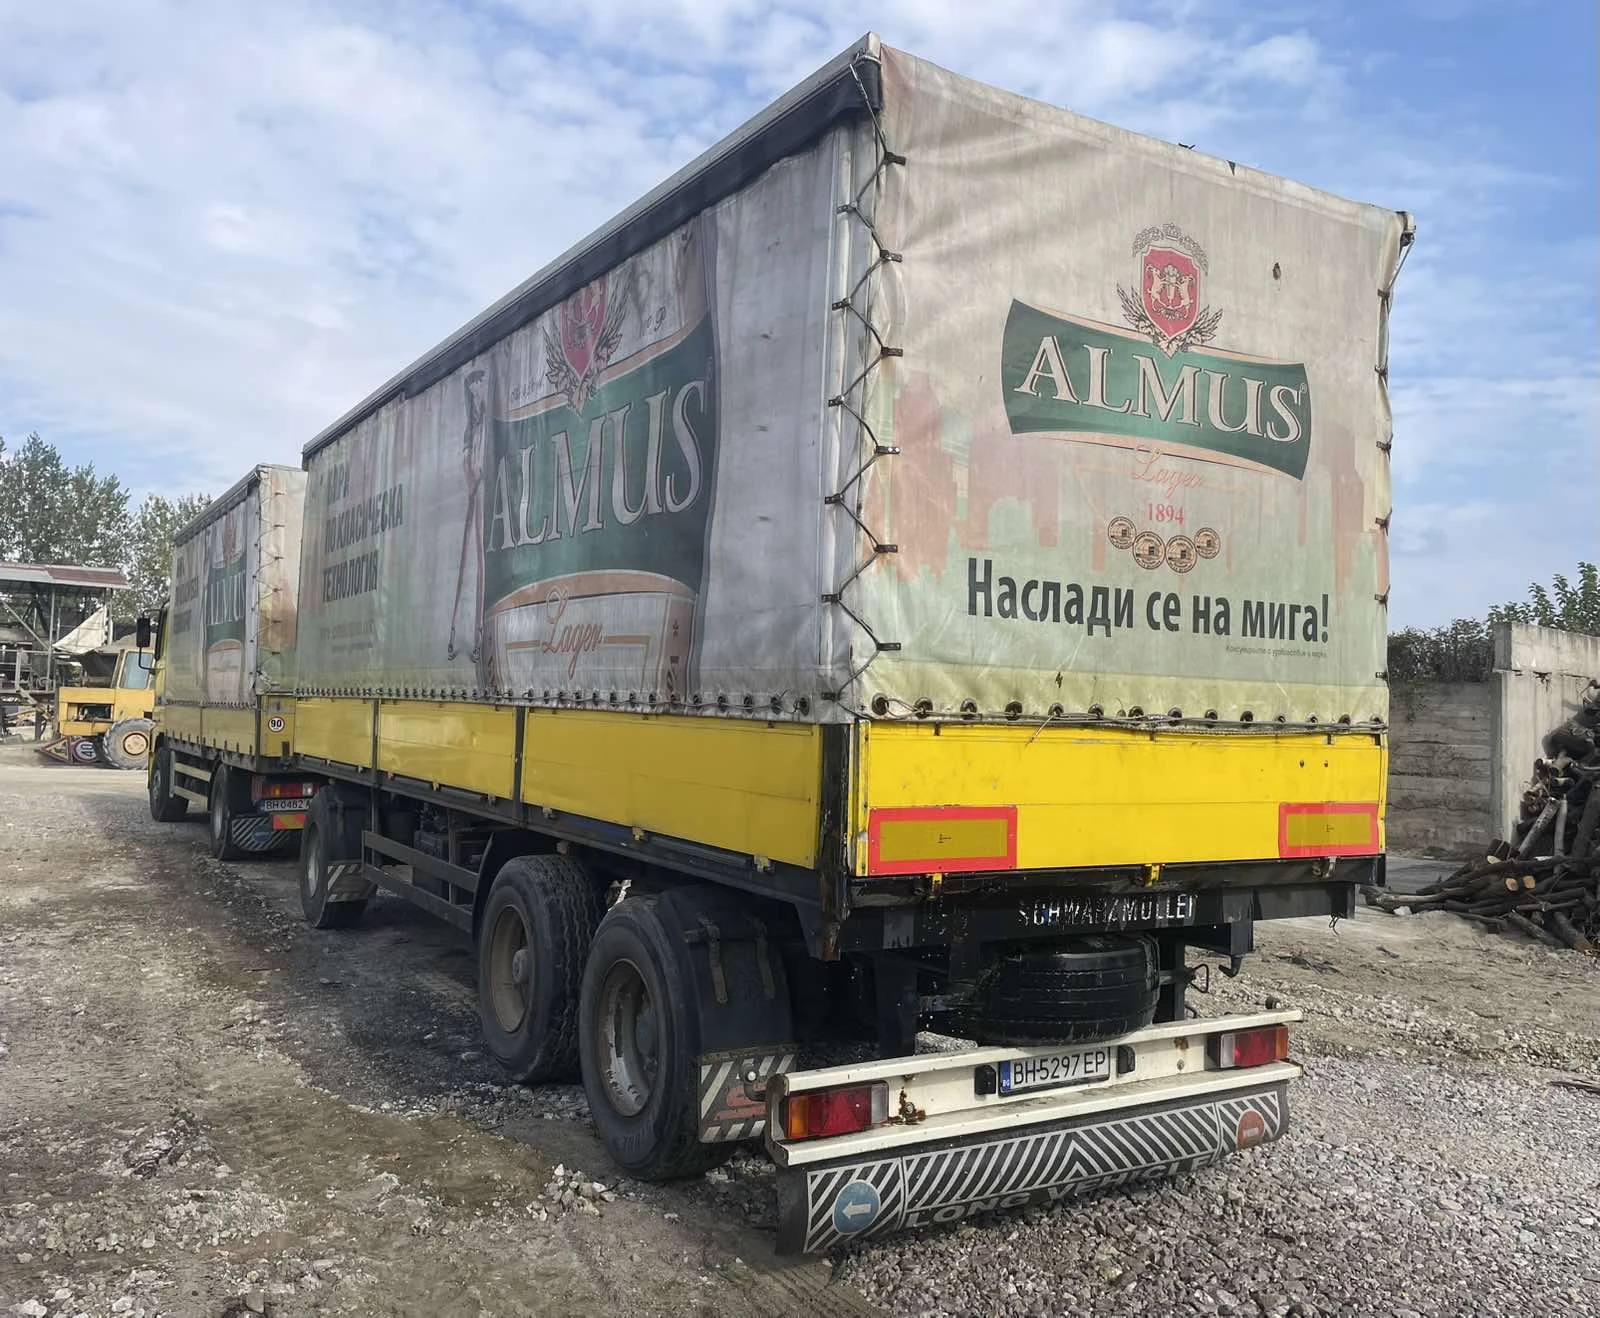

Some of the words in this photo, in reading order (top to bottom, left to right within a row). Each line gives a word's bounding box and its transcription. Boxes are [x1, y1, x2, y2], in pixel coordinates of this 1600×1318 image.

[1013, 335, 1302, 443] ALMUS
[486, 378, 707, 553] ALMUS
[1147, 503, 1185, 525] 1894
[322, 549, 379, 604] ТЕХНОЛОГИЯ
[967, 557, 1135, 638] Наслади
[1146, 591, 1181, 632] се
[1192, 594, 1231, 636] на
[1241, 593, 1330, 644] мига!
[541, 586, 606, 681] Lager
[270, 719, 282, 728] 90
[1013, 1060, 1036, 1085] BH
[1039, 1054, 1080, 1081] 5297
[1083, 1051, 1106, 1074] EP
